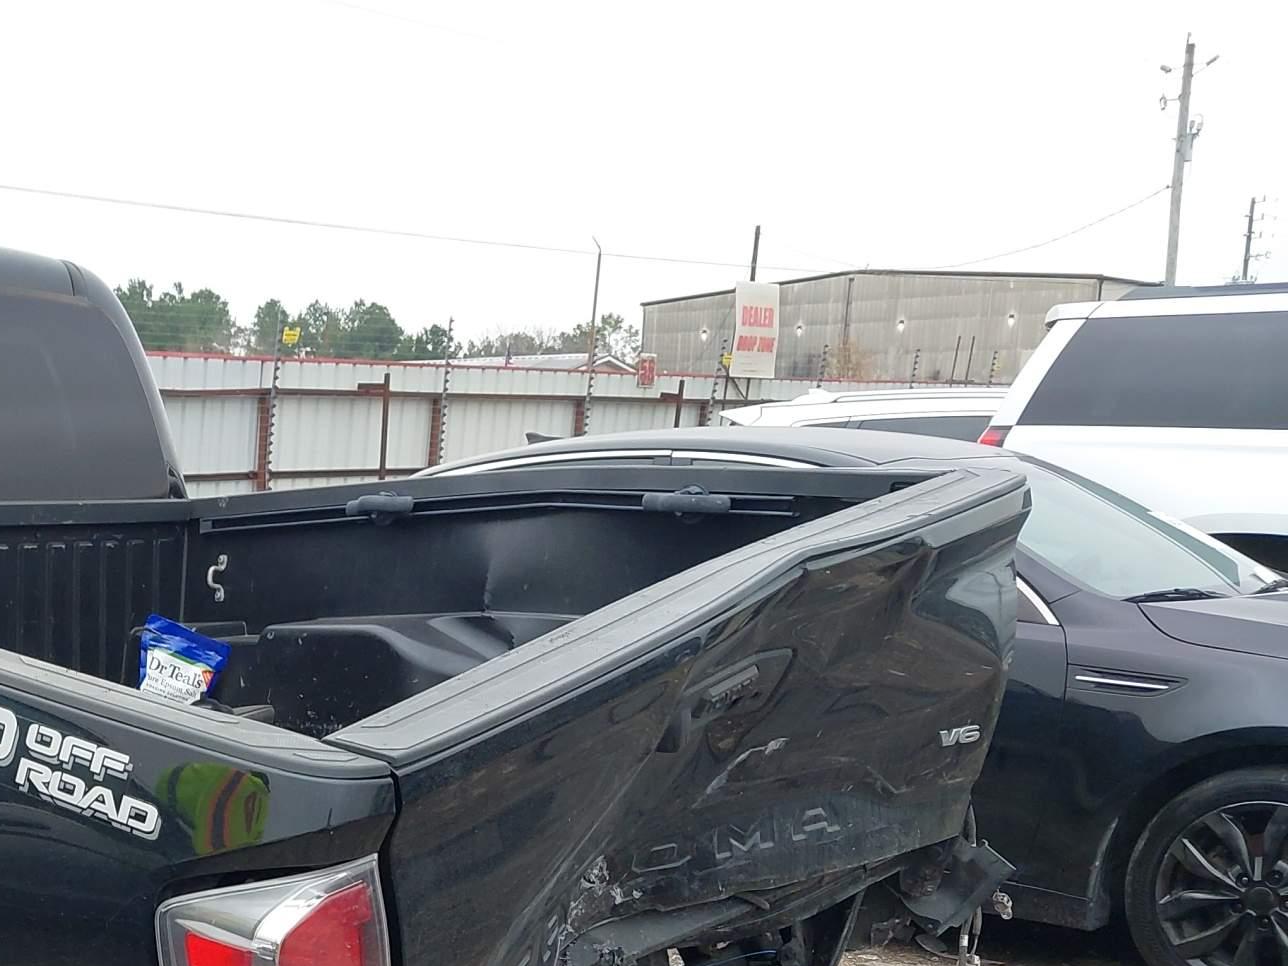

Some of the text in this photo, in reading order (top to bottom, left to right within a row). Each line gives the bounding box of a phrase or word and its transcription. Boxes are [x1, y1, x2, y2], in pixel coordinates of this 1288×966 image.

[740, 305, 774, 328] DEALER
[148, 656, 168, 674] Dr
[938, 725, 981, 747] V6
[25, 722, 134, 783] OFF
[14, 756, 162, 841] ROAD
